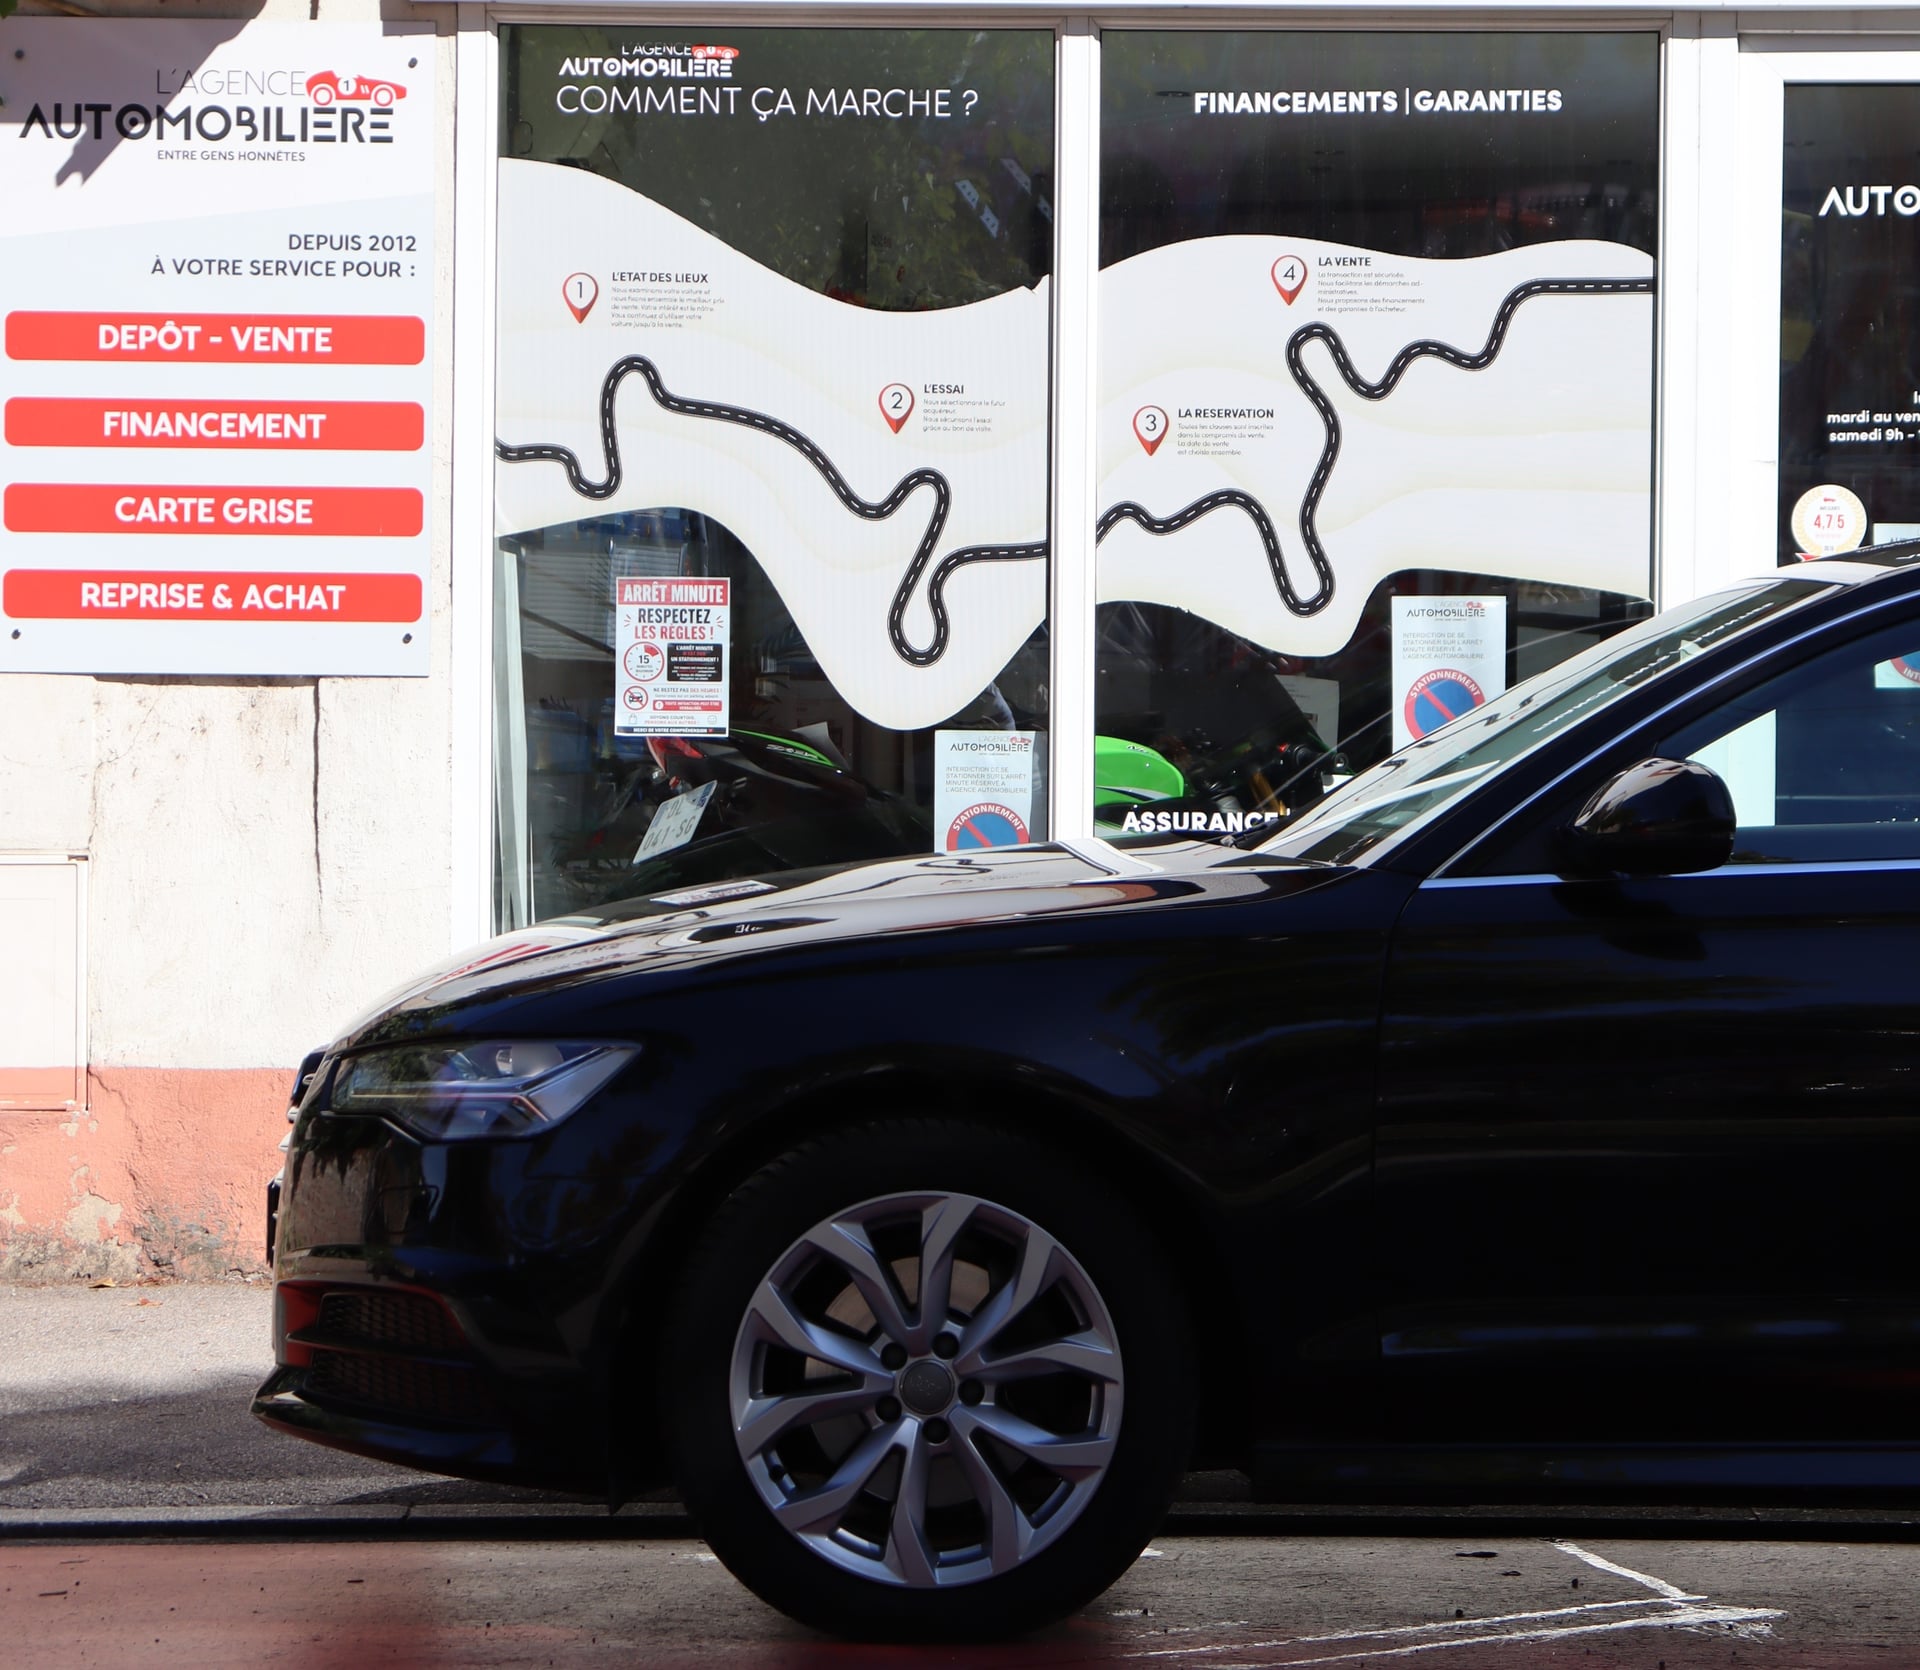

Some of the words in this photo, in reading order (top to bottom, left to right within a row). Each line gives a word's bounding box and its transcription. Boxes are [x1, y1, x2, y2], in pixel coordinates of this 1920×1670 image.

[156, 68, 306, 96] L'AGENCE
[556, 85, 742, 116] COMMENT
[751, 86, 796, 122] ÇA
[805, 88, 951, 117] MARCHE
[962, 89, 979, 116] ?
[1194, 91, 1398, 113] FINANCEMENTS
[1414, 90, 1562, 112] GARANTIES
[157, 150, 197, 161] ENTRE
[200, 150, 234, 161] GENS
[238, 149, 306, 162] HONNÊTES
[288, 234, 362, 251] DEPUIS
[368, 235, 417, 252] 2012
[151, 255, 165, 275] À
[173, 258, 243, 276] VOTRE
[249, 259, 336, 277] SERVICE
[342, 261, 401, 278] POUR
[1318, 257, 1333, 267] LA
[1336, 257, 1371, 267] VENTE
[612, 272, 647, 282] L'ETAT
[650, 272, 672, 282] DES
[675, 273, 709, 283] LIEUX
[1284, 264, 1296, 281] 4
[577, 281, 583, 298] 1
[98, 321, 201, 351] DEPÔT
[231, 326, 332, 352] VENTE
[924, 384, 964, 394] L'ESSAI
[891, 392, 903, 409] 2
[1178, 408, 1192, 418] LA
[1195, 408, 1274, 418] RESERVATION
[1827, 410, 1870, 423] mardi
[1873, 413, 1892, 423] au
[103, 410, 326, 439] FINANCEMENT
[1145, 414, 1157, 431] 3
[1829, 428, 1882, 441] samedi
[1885, 428, 1904, 440] 9h
[115, 497, 215, 523] CARTE
[222, 498, 313, 524] GRISE
[81, 582, 204, 609] REPRISE
[212, 583, 233, 610] &
[242, 584, 346, 610] ACHAT
[623, 581, 667, 602] ARRÊT
[671, 585, 723, 603] MINUTE
[638, 608, 711, 624] RESPECTEZ
[635, 625, 656, 640] LES
[710, 626, 714, 640] !
[638, 655, 650, 664] 15
[1410, 670, 1480, 698] STATIONNEMENT
[952, 804, 1024, 831] STATIONNEMENT
